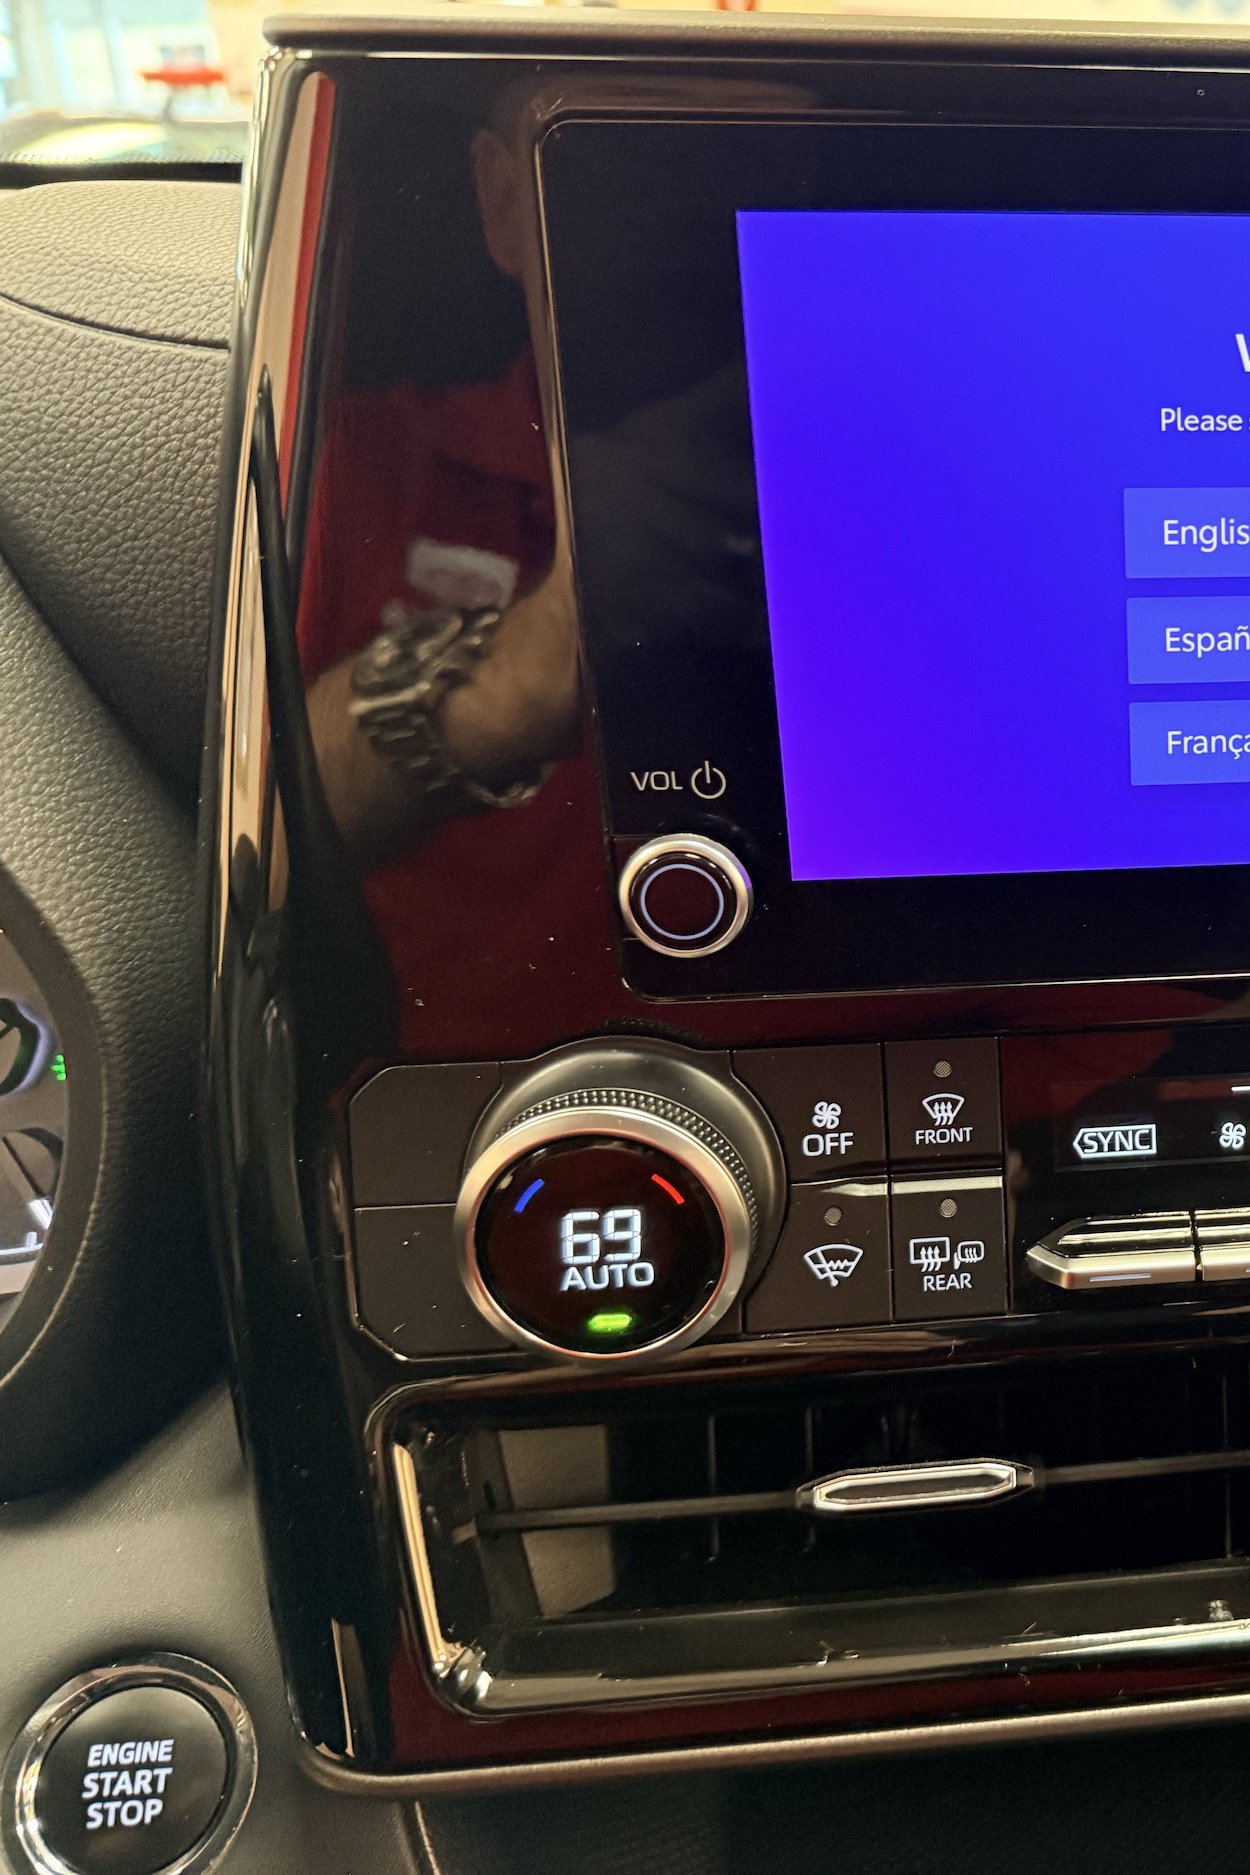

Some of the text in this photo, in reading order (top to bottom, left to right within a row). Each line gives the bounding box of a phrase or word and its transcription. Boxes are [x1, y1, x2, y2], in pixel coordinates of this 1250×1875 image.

[1160, 408, 1243, 432] Please
[630, 770, 684, 791] VOL
[802, 1131, 854, 1157] OFF
[914, 1126, 975, 1145] FRONT
[1082, 1130, 1152, 1154] SYNC
[559, 1207, 643, 1264] 69
[559, 1261, 656, 1292] AUTO
[922, 1272, 973, 1292] REAR
[87, 1738, 174, 1768] ENGINE
[81, 1767, 173, 1799] START
[86, 1798, 163, 1830] STOP
